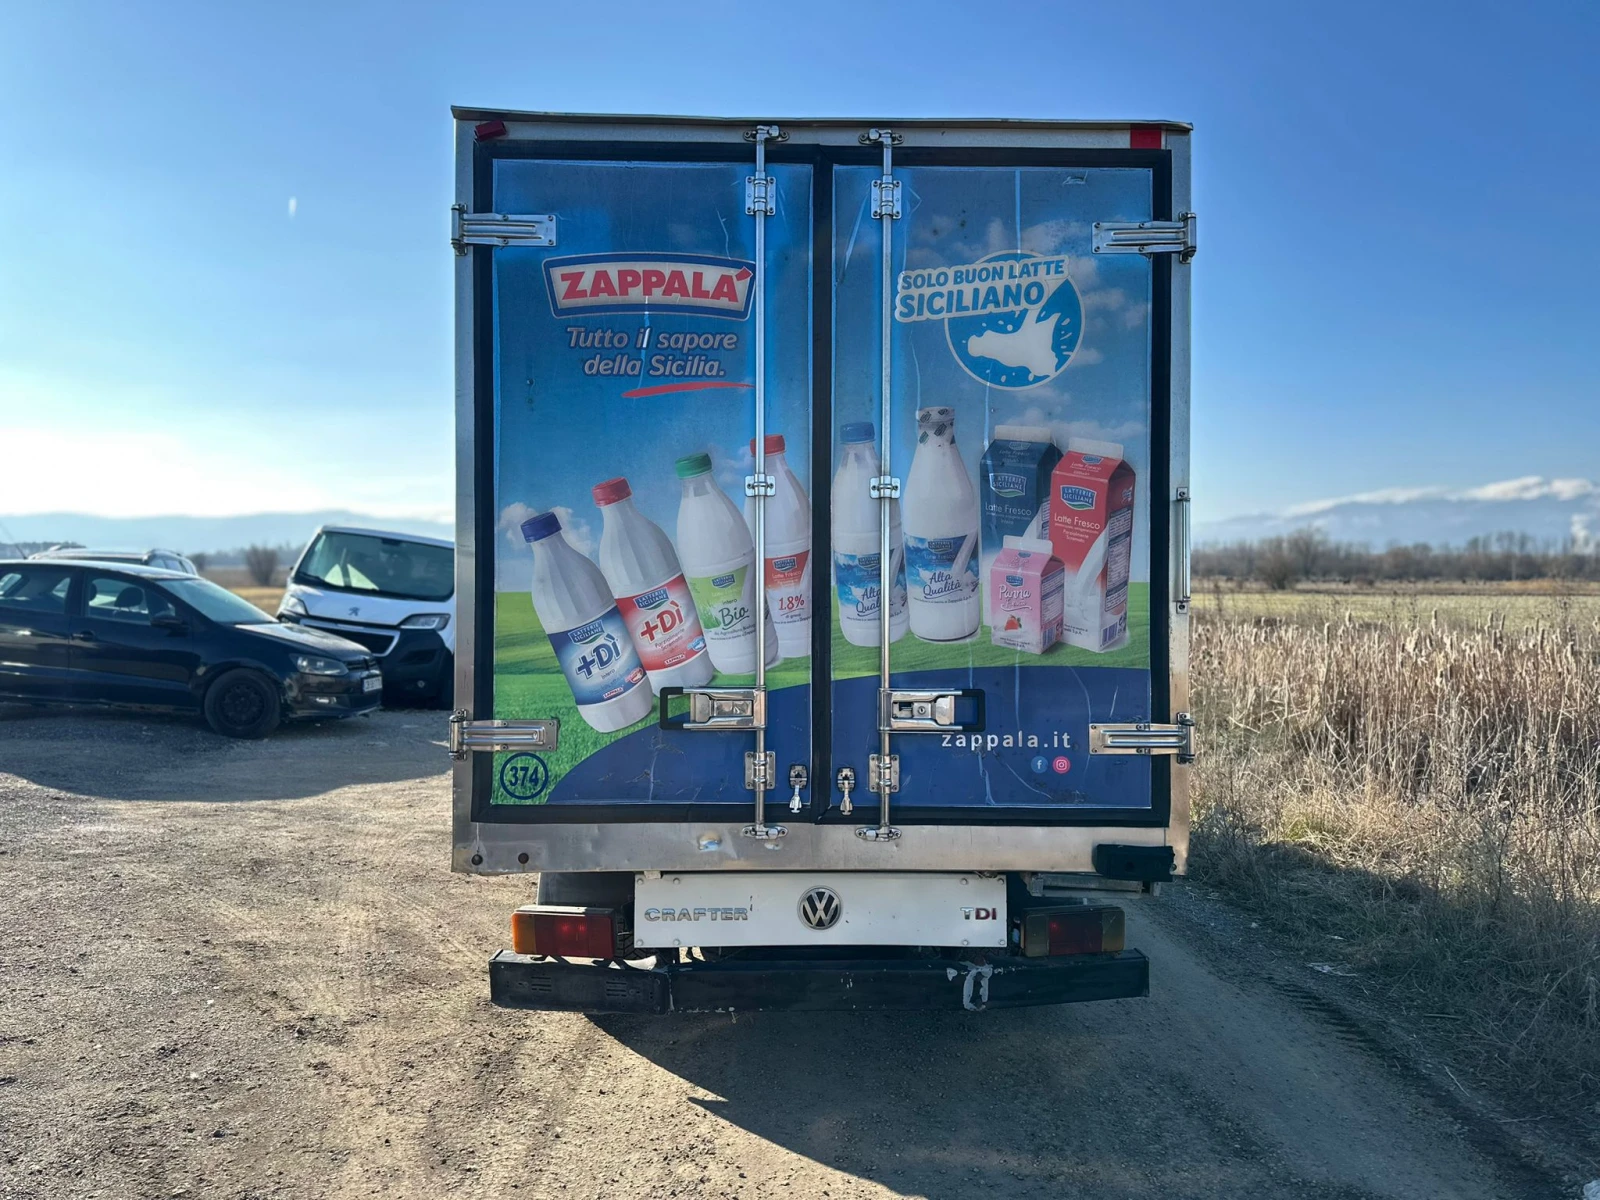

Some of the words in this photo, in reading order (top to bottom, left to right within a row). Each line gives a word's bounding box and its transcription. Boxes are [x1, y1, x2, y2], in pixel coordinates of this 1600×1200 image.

[901, 271, 949, 291] SOLO
[953, 266, 1004, 286] BUON
[1008, 259, 1066, 279] LATTE
[899, 281, 1046, 319] SICILIANO
[567, 327, 629, 348] Tutto
[635, 327, 651, 348] il
[657, 332, 738, 354] sapore
[584, 354, 641, 376] della
[650, 355, 726, 377] Sicilia.
[997, 474, 1022, 484] ATTERIE
[1063, 494, 1092, 503] SICILIANE
[1064, 488, 1092, 498] LATTERIE
[985, 502, 1003, 513] Latte
[1004, 504, 1032, 516] Fresco
[1054, 513, 1072, 525] Latte
[1074, 516, 1101, 530] Fresco
[929, 571, 953, 585] Alta
[923, 580, 961, 597] Qualità
[998, 584, 1031, 601] Panna
[778, 593, 805, 611] 1.8%
[718, 606, 749, 627] Bio
[941, 730, 1071, 752] zappala.it
[508, 766, 540, 787] 374
[643, 907, 749, 922] CRAFTER
[959, 906, 998, 921] TDI
